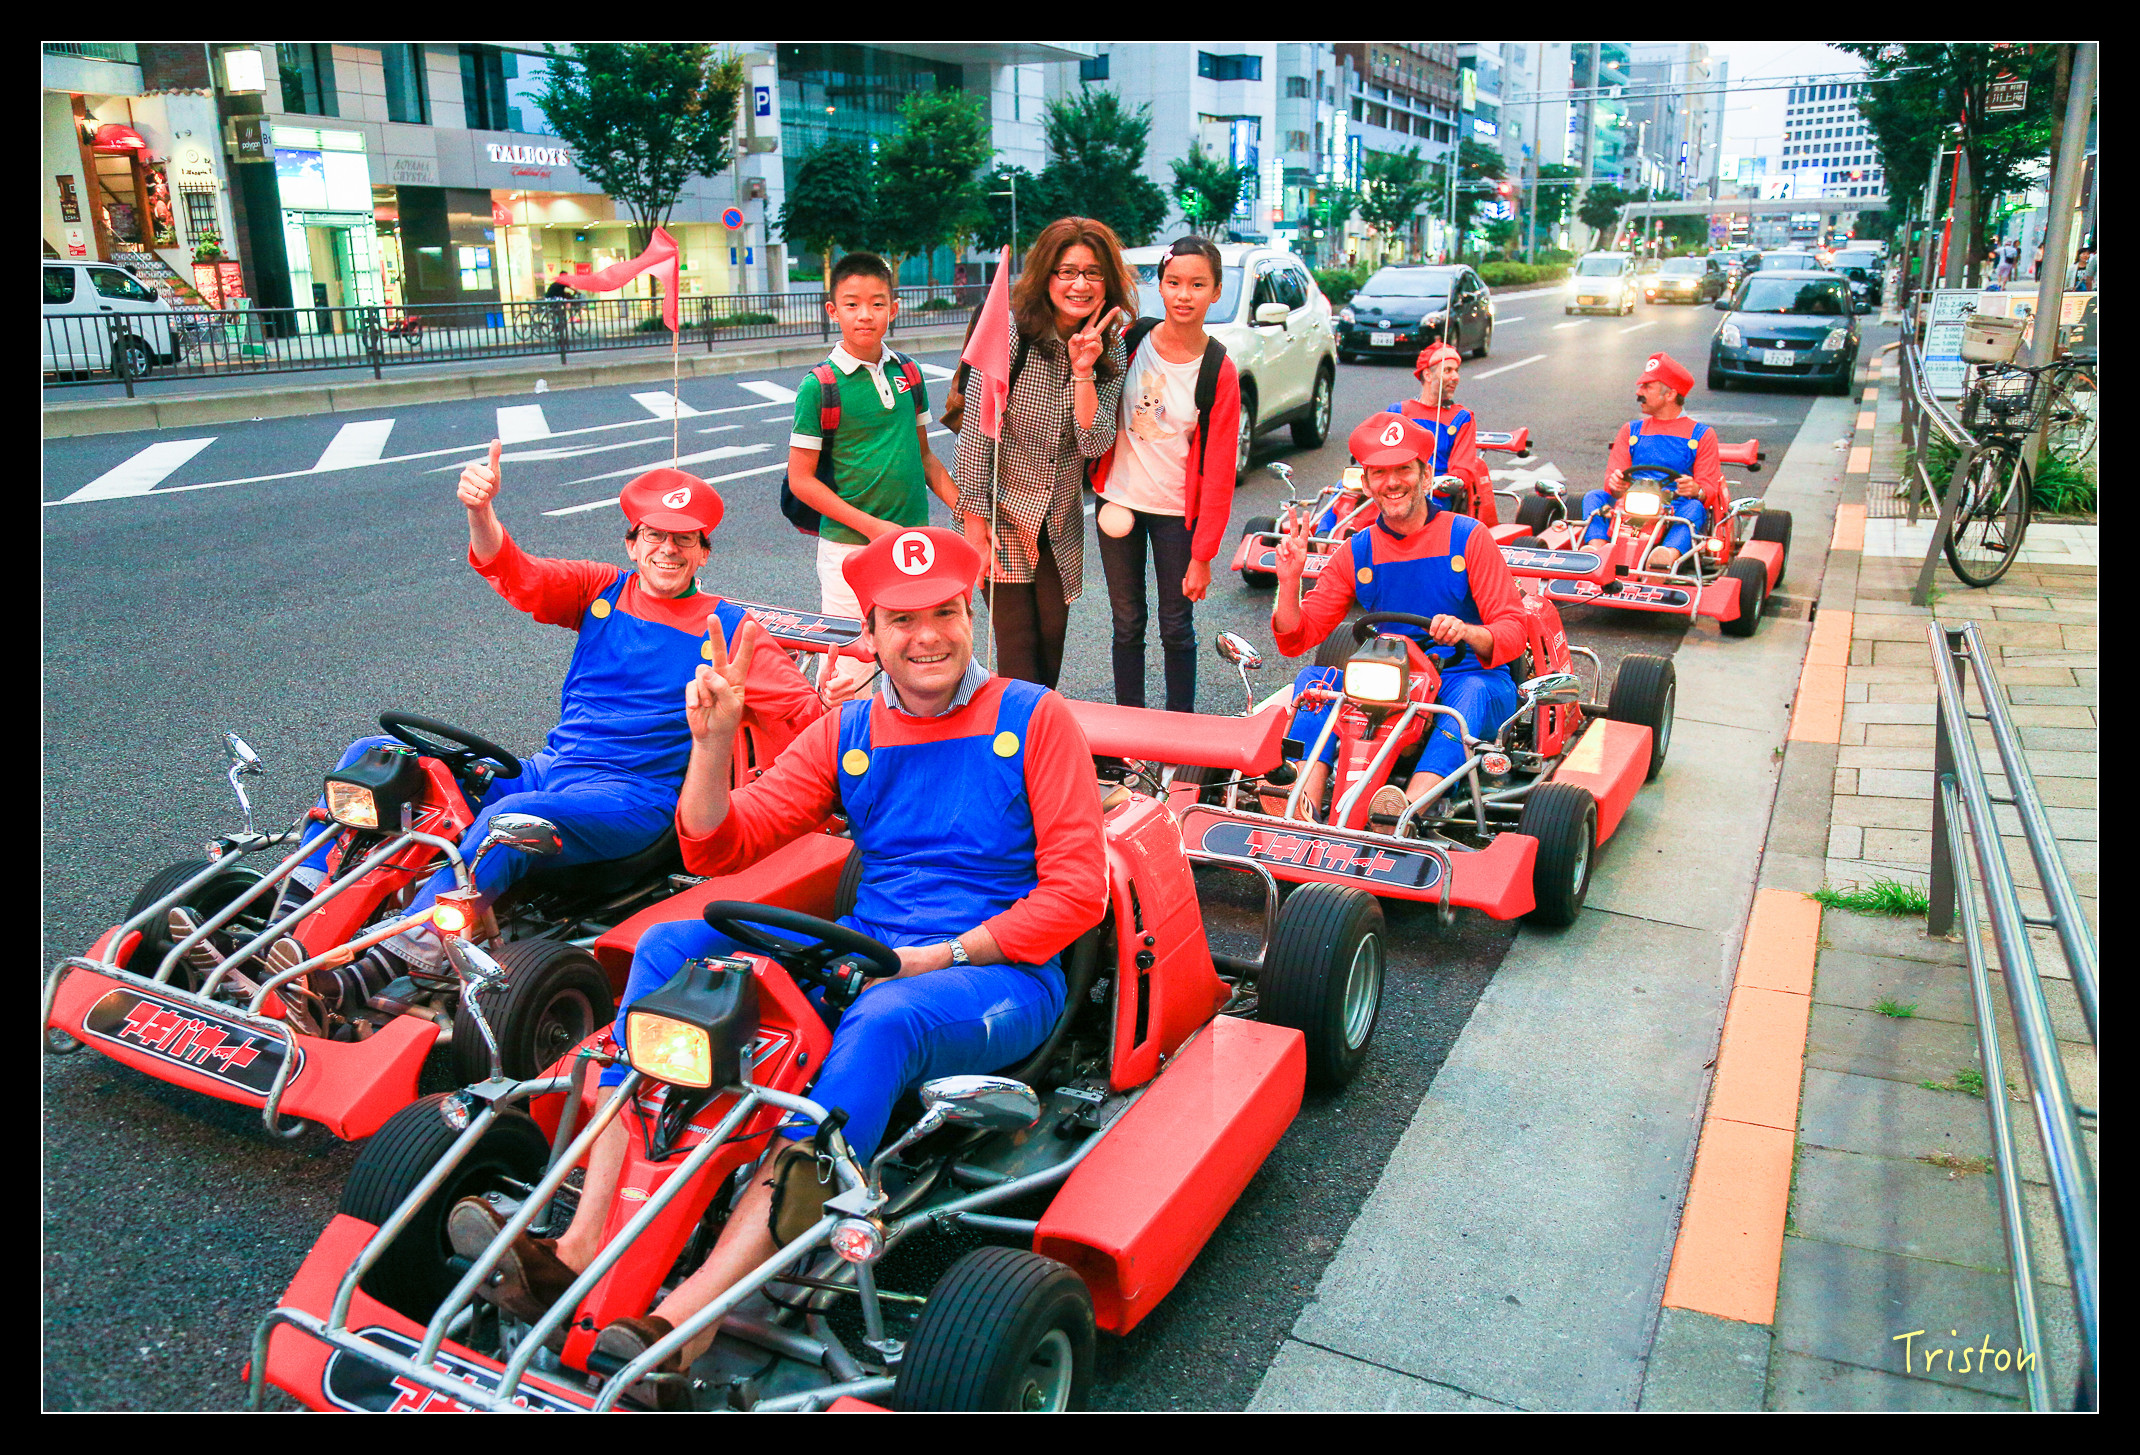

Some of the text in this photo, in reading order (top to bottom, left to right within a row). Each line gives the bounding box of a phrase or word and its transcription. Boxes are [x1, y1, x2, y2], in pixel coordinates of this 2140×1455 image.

[756, 91, 769, 112] P
[486, 143, 571, 167] TALBOTS
[1385, 426, 1399, 441] R
[667, 491, 686, 504] R
[903, 539, 928, 568] R
[1573, 580, 1664, 602] アキカート
[1244, 829, 1397, 876] アキバカート
[118, 1000, 261, 1073] アキバカート
